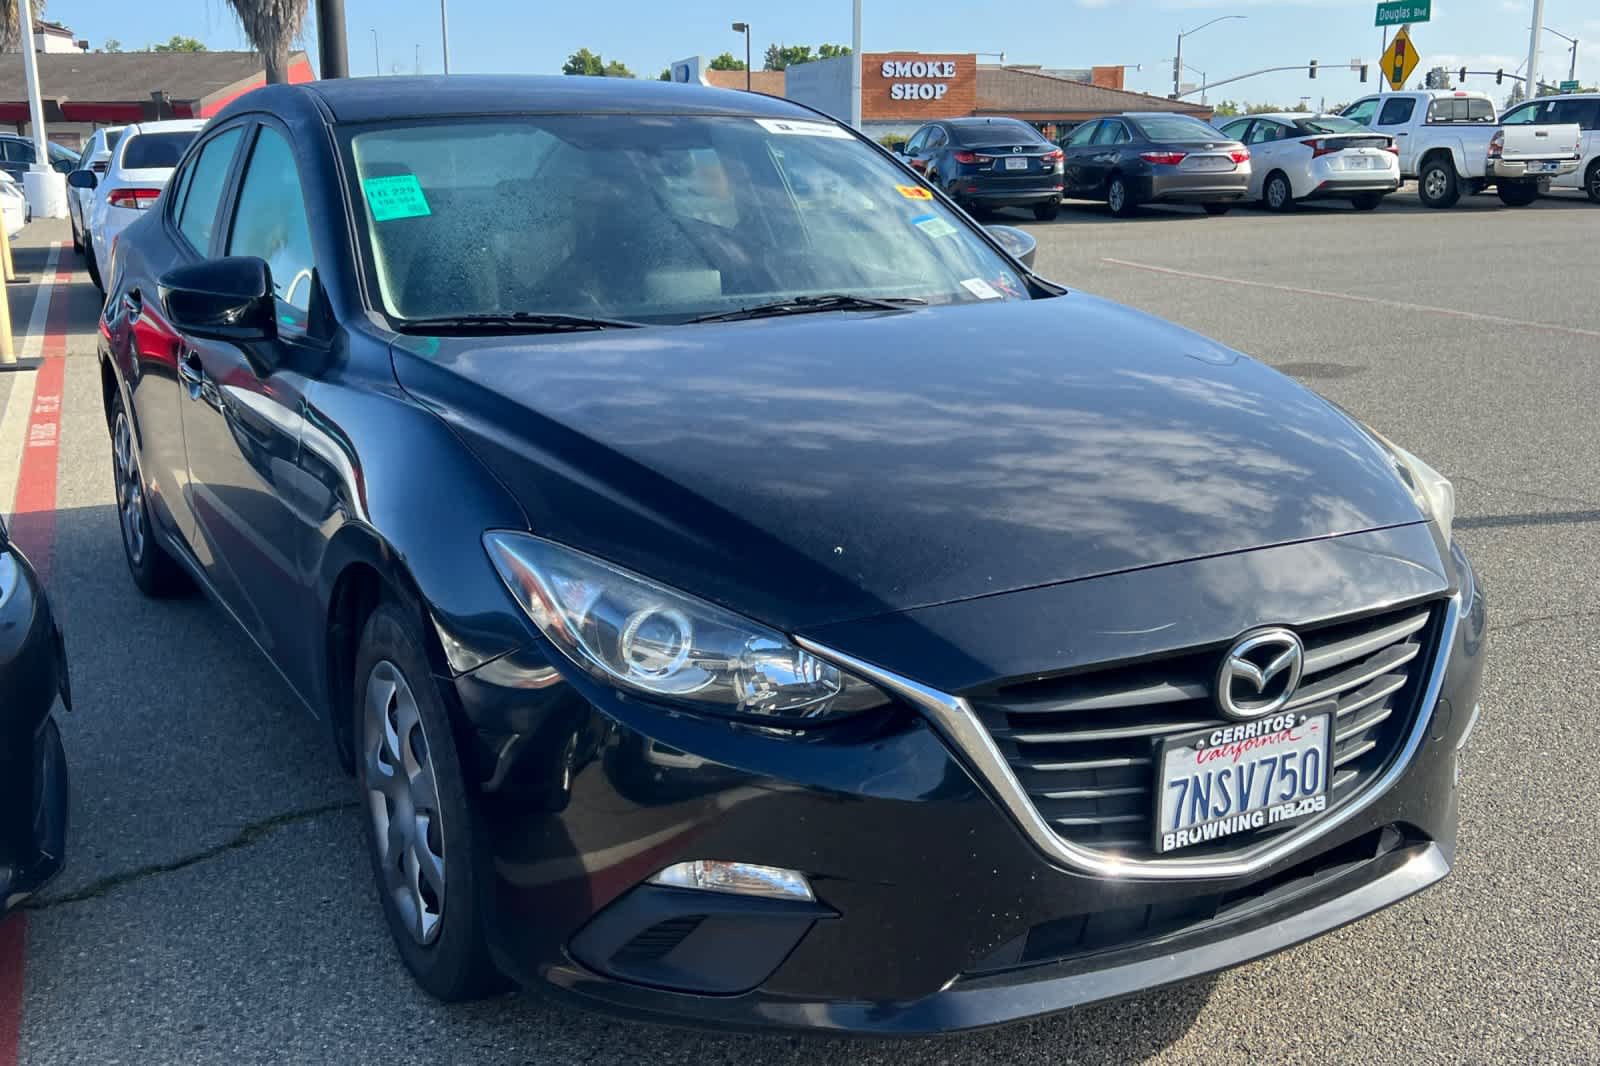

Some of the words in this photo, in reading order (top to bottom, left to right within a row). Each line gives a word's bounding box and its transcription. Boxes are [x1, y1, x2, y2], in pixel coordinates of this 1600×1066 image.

[1379, 6, 1410, 22] Douglas
[1413, 7, 1427, 17] Blvd
[882, 61, 956, 78] SMOKE
[891, 83, 948, 100] SHOP
[1210, 714, 1295, 746] CERRITOS
[1197, 729, 1301, 764] California
[1170, 747, 1320, 830] 7NSV750
[1163, 810, 1264, 851] BROWNING
